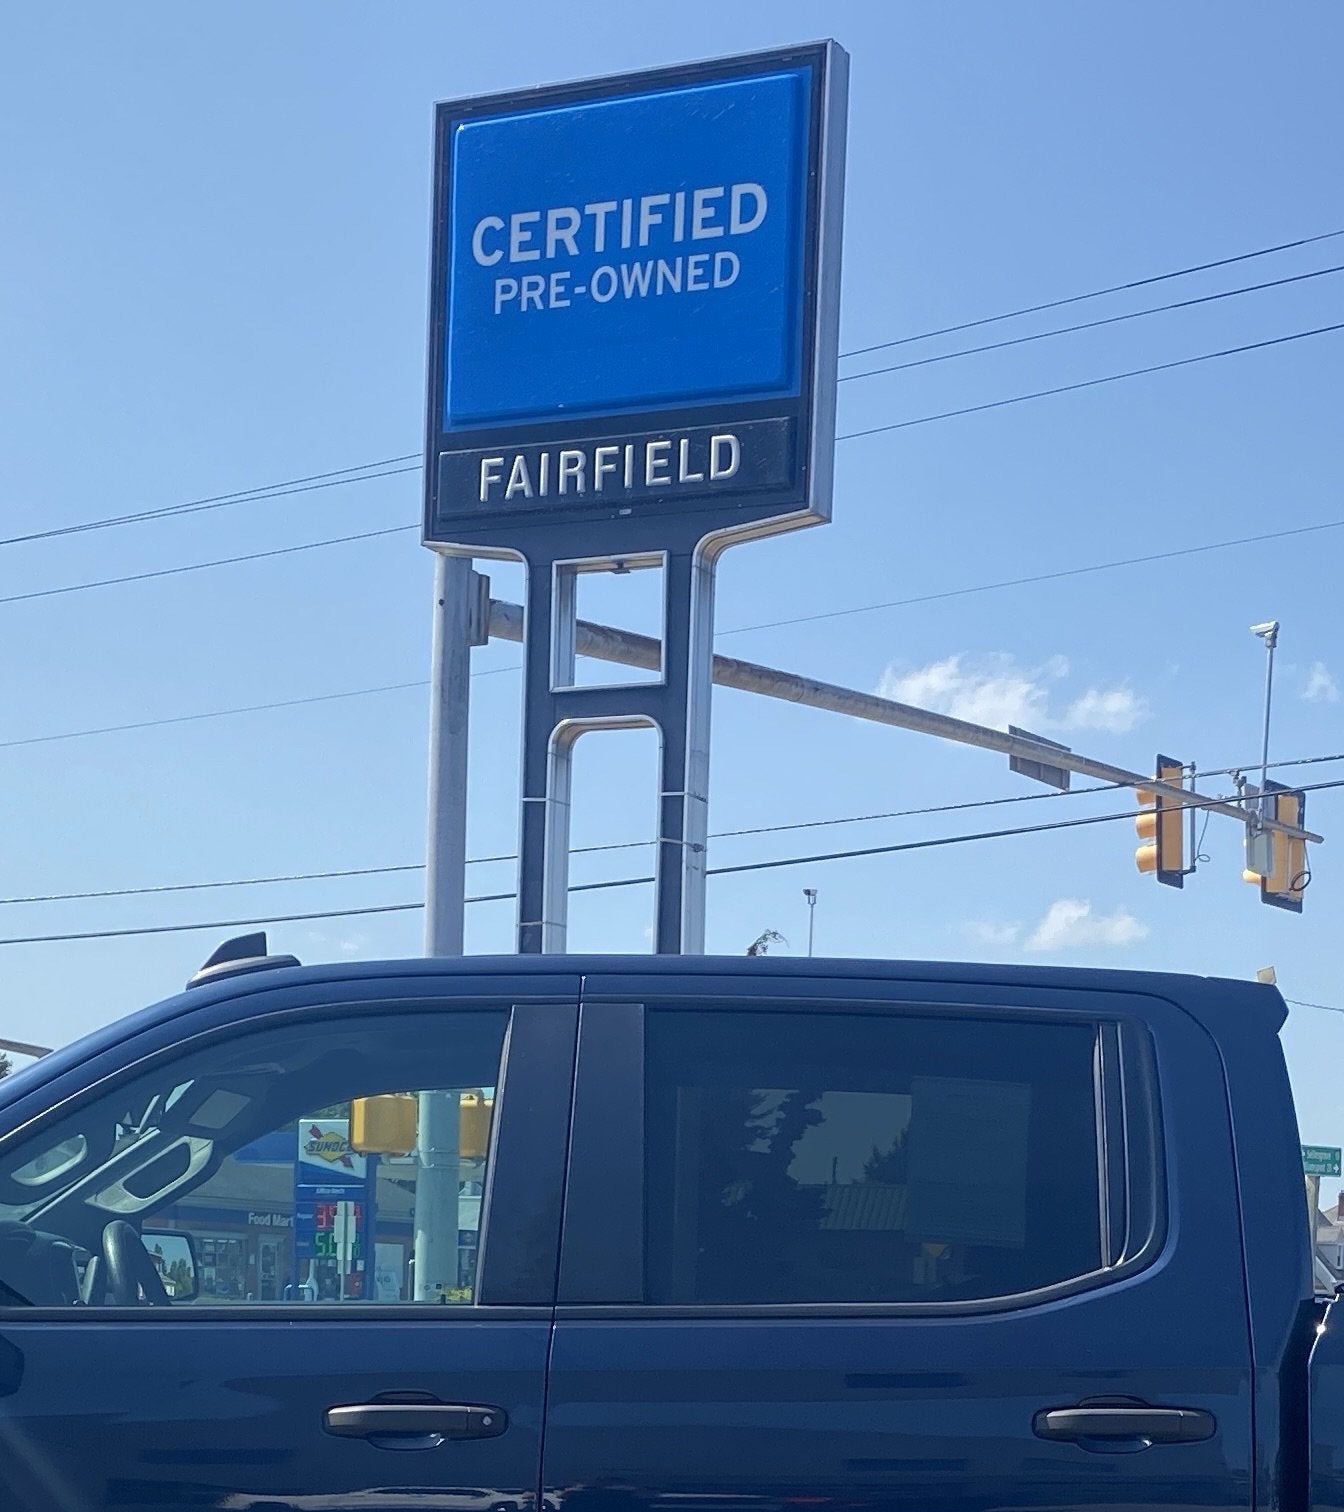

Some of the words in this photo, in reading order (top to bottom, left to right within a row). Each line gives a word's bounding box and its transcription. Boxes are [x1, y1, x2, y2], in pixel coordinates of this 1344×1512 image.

[472, 182, 768, 267] CERTIFIED
[494, 251, 741, 315] PRE-OWNED
[479, 433, 742, 502] FAIRFIELD
[308, 1138, 351, 1153] SUNOC
[248, 1212, 271, 1226] Food
